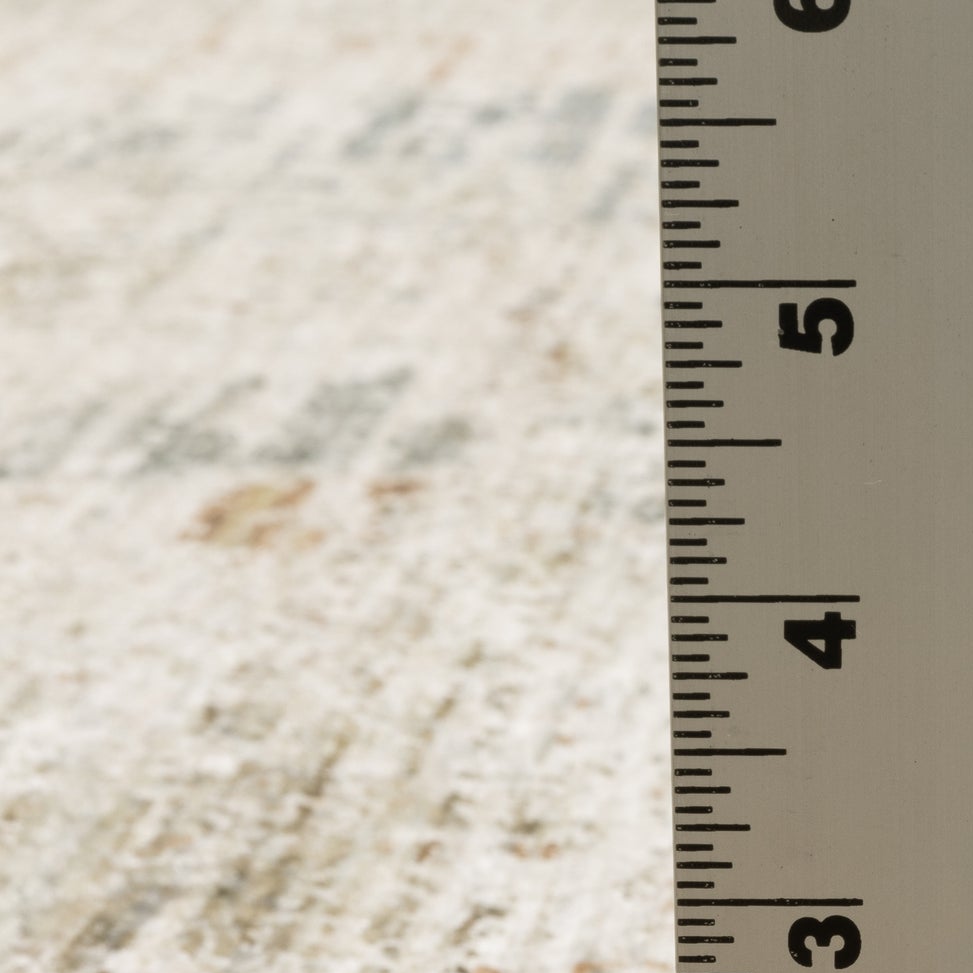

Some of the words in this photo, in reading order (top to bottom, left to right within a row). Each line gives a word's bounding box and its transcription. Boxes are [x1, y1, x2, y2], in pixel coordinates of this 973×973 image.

[777, 297, 855, 357] 5
[783, 611, 857, 670] 4
[787, 914, 862, 970] 3
